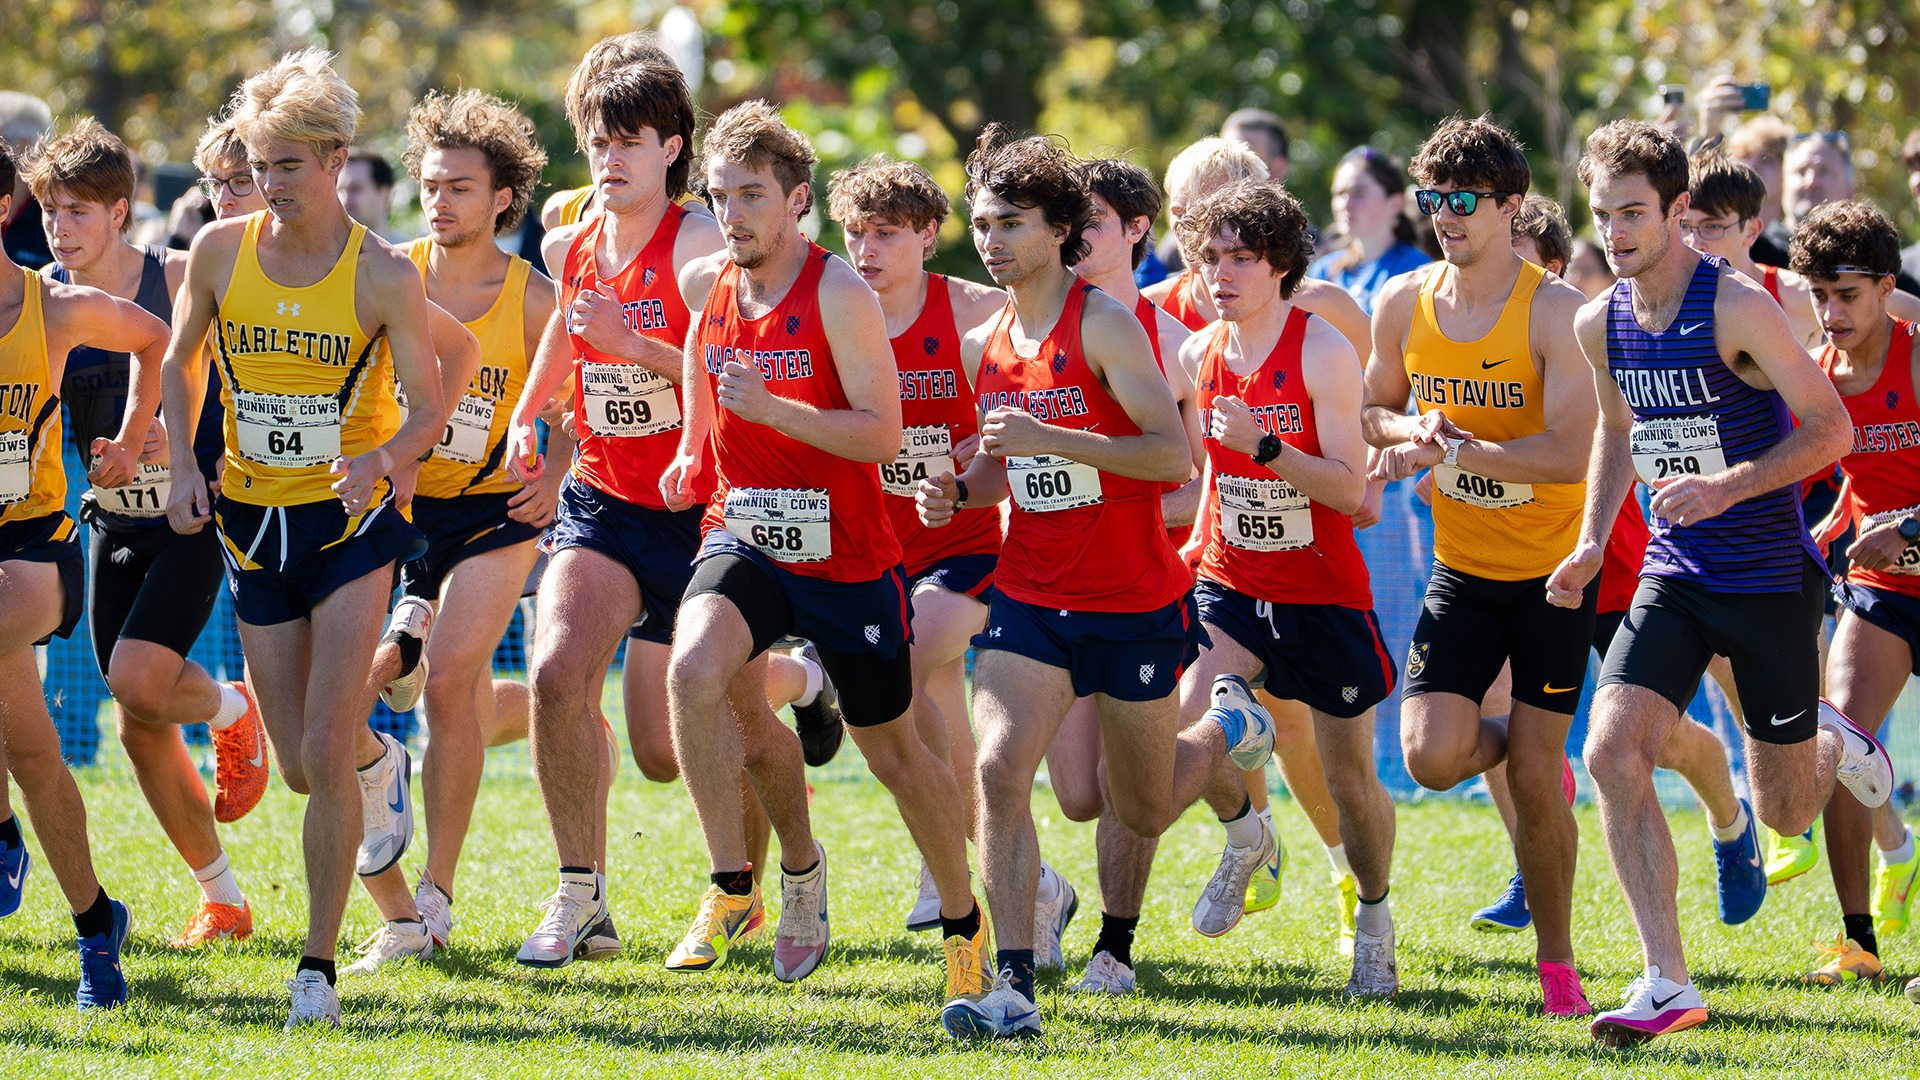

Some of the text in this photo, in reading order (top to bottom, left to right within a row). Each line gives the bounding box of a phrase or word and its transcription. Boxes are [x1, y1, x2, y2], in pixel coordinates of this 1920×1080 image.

[226, 319, 352, 367] CARLETON
[585, 371, 623, 385] RUNNING
[1411, 372, 1525, 409] GUSTAVUS
[1615, 368, 1720, 407] CORNELL
[237, 398, 287, 415] RUNNING
[299, 402, 337, 416] COWS
[253, 396, 286, 404] CARLETON
[457, 401, 492, 419] COWS
[604, 399, 652, 426] 659
[902, 429, 929, 437] COLLEGE
[1632, 428, 1674, 442] RUNNING
[1682, 424, 1716, 439] COWS
[1673, 420, 1698, 428] COLLEGE
[268, 430, 304, 456] 64
[913, 433, 949, 446] COWS
[288, 454, 325, 462] CHAMPIONSHIP
[1655, 456, 1701, 478] 259
[881, 462, 929, 486] 654
[1026, 470, 1072, 499] 660
[1218, 482, 1259, 499] RUNNING
[1230, 479, 1257, 488] CARLETON
[1456, 473, 1505, 499] 406
[115, 487, 160, 509] 171
[728, 495, 778, 509] RUNNING
[790, 498, 828, 511] COWS
[748, 490, 779, 498] CARLETON
[1050, 495, 1086, 504] CHAMPIONSHIP
[1237, 513, 1285, 540] 655
[751, 524, 803, 551] 658
